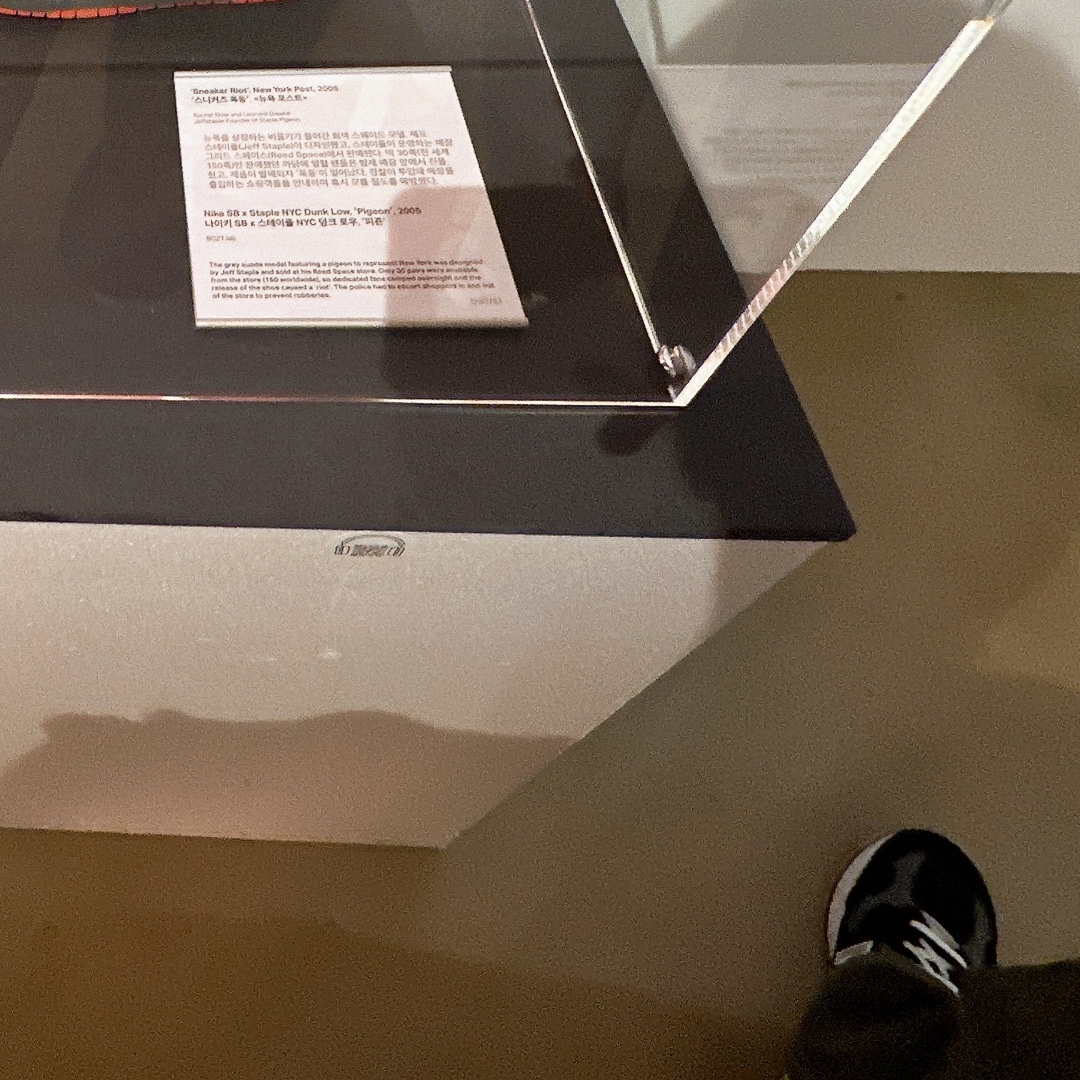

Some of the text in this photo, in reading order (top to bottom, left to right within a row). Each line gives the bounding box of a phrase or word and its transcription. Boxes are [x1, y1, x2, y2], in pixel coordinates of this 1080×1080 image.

[226, 209, 240, 217] SB
[249, 209, 280, 218] Staple
[281, 208, 302, 216] NYC
[304, 208, 329, 216] Dunk
[331, 208, 352, 216] Low,
[397, 206, 422, 215] 2005
